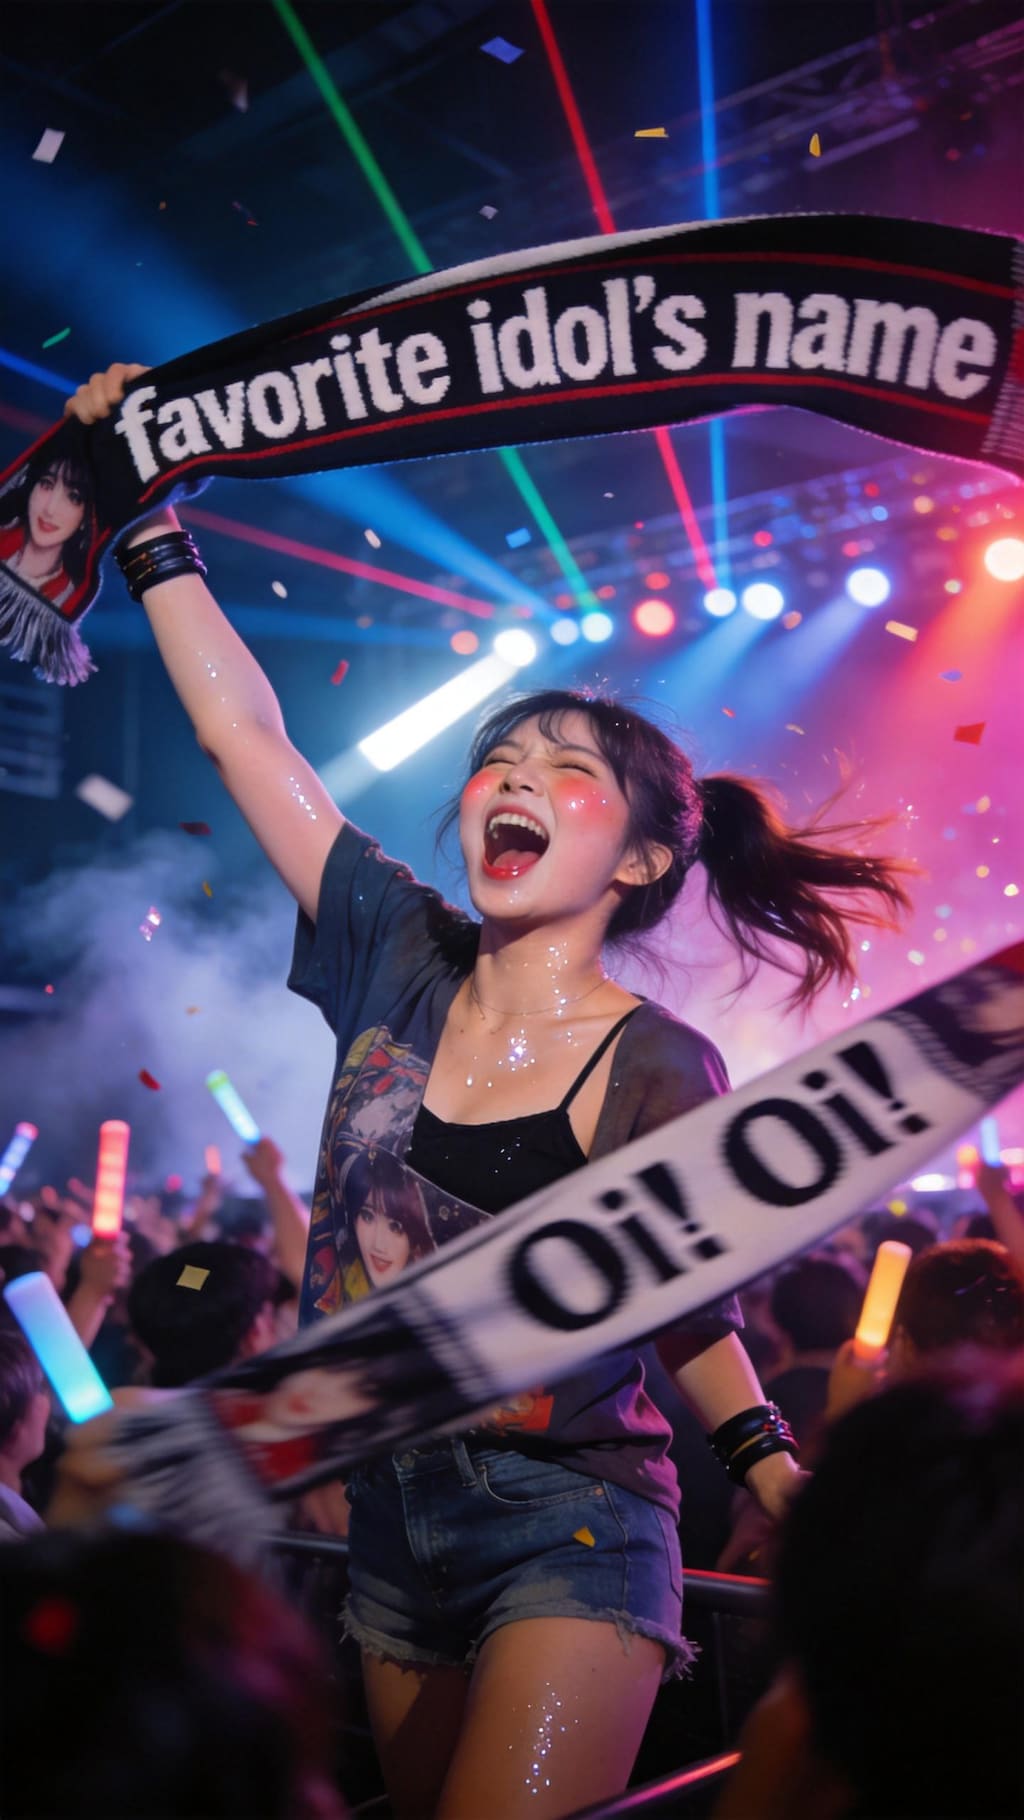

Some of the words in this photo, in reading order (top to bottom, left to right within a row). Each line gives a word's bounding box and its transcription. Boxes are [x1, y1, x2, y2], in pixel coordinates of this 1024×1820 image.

[115, 328, 450, 483] favorite
[466, 274, 708, 393] idol's
[731, 290, 998, 399] name
[508, 1162, 728, 1331] Oi!
[721, 1042, 932, 1207] Oi!
